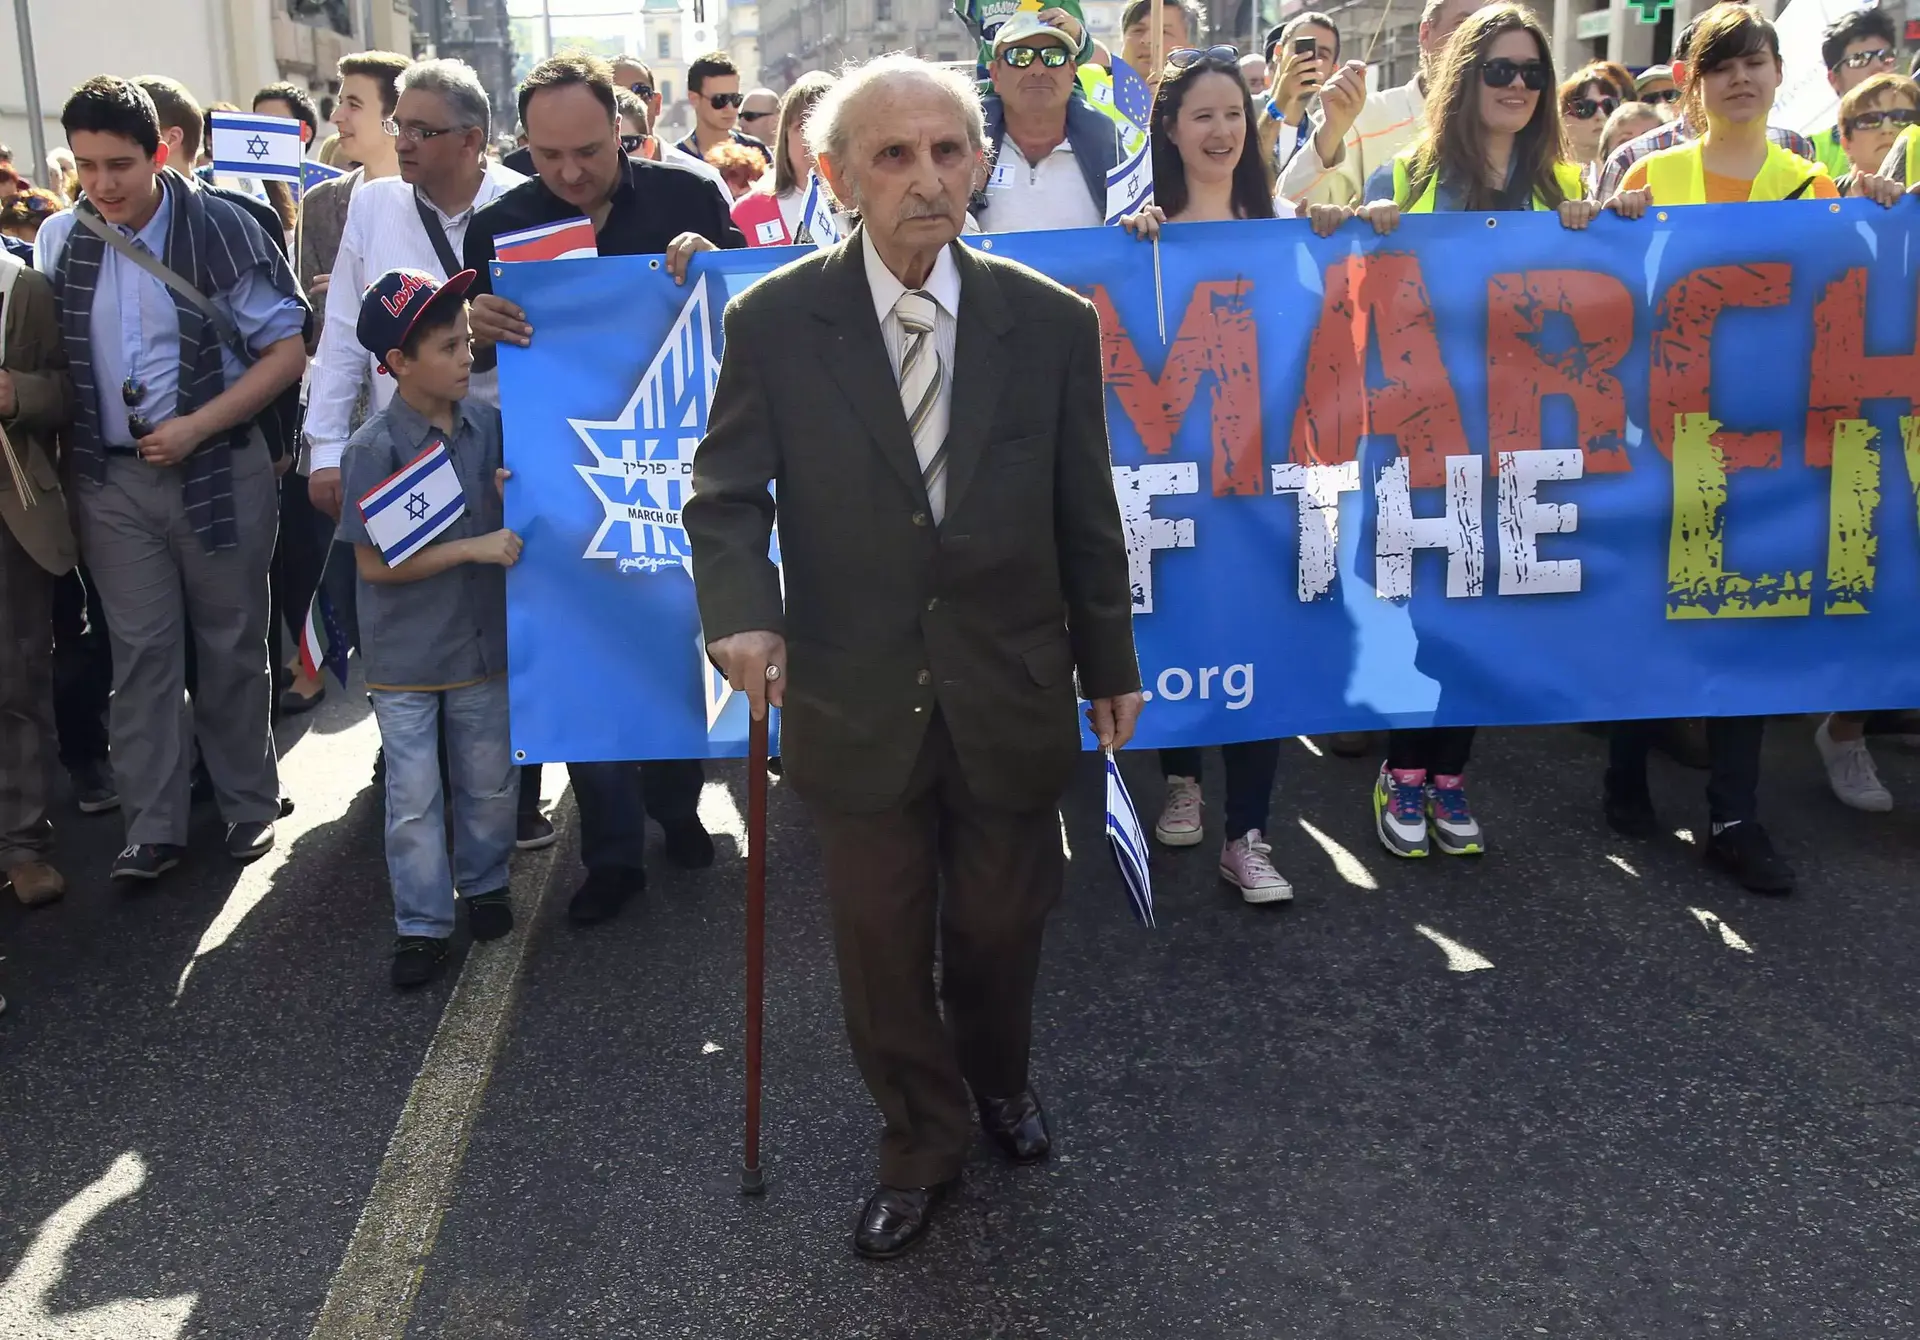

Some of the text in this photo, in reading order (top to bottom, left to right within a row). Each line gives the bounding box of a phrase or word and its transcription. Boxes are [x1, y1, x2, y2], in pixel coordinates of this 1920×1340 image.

[380, 287, 410, 319] Los
[1070, 252, 1920, 497] MARCH
[622, 460, 668, 476] פולין
[627, 507, 679, 525] MARCH OF
[1111, 411, 1920, 621] F THE LI
